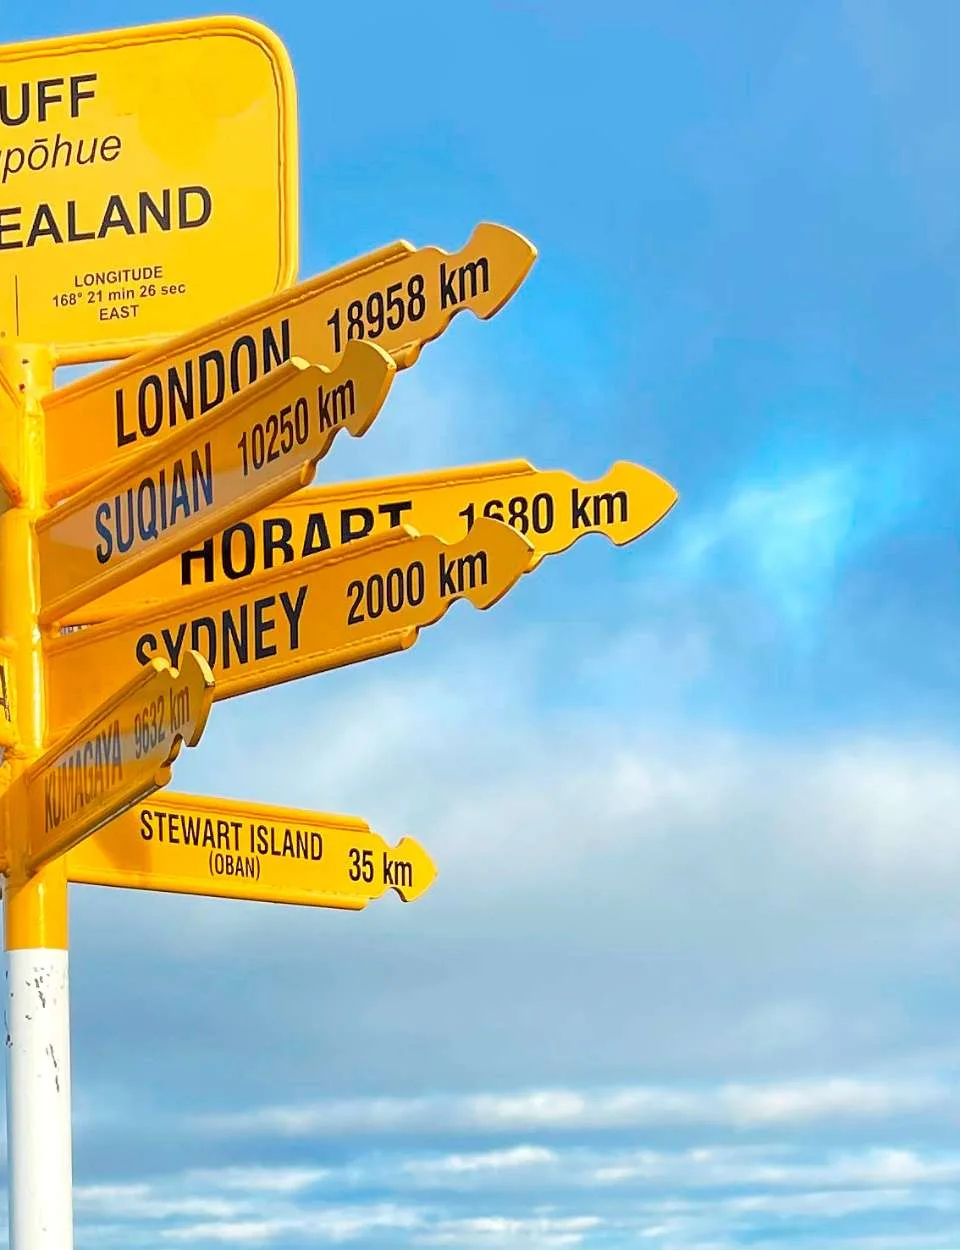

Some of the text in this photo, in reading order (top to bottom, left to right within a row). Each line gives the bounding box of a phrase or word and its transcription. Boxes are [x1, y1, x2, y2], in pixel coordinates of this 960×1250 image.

[52, 284, 186, 308] 168° 21 min 26 sec
[74, 265, 164, 289] LONGITUDE
[99, 304, 139, 321] EAST
[115, 255, 490, 448] LONDON 18958 km
[95, 376, 357, 565] SUQIAN 10250 km
[571, 488, 628, 530] km
[135, 550, 488, 672] SYDNEY 2000 km
[133, 695, 165, 760] 9632
[169, 686, 190, 733] km
[140, 809, 323, 861] STEWART ISLAND
[208, 850, 261, 881] (OBAN)
[348, 848, 413, 888] 35 km
